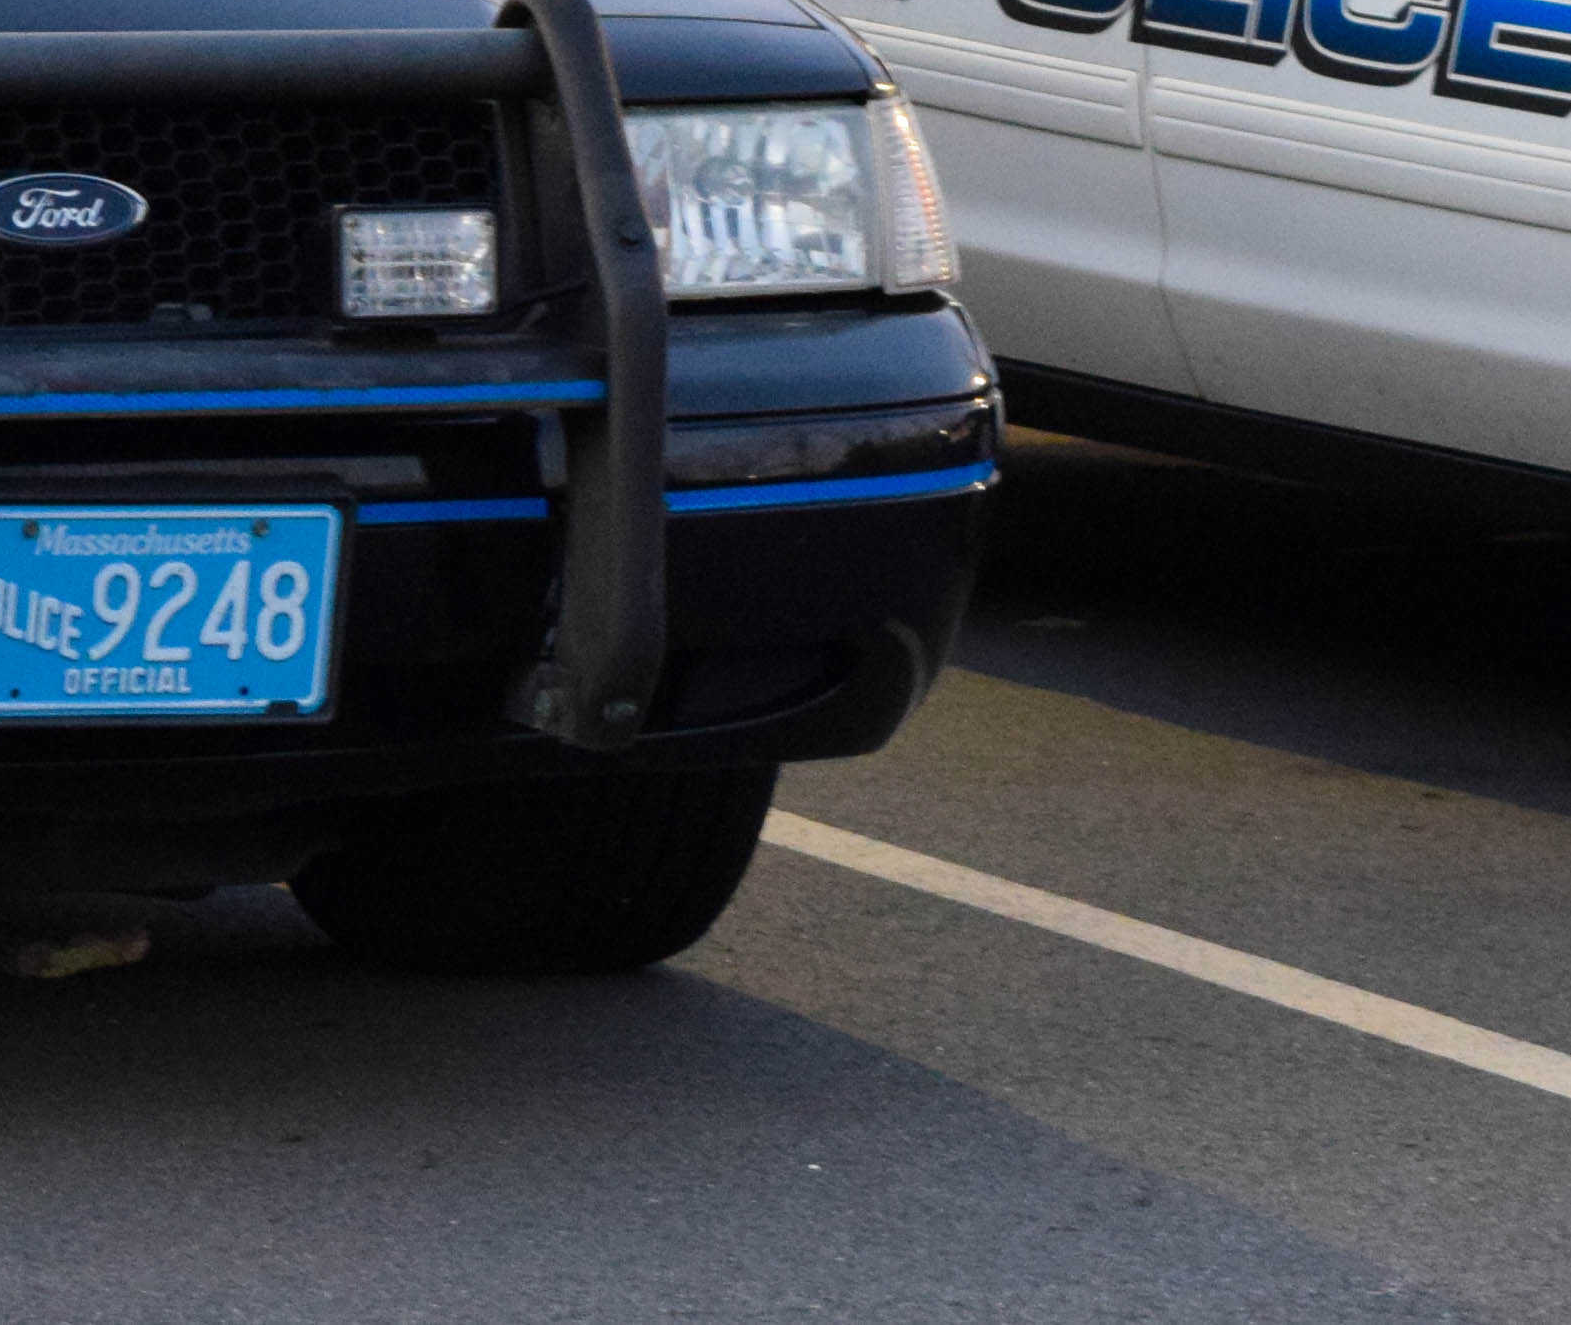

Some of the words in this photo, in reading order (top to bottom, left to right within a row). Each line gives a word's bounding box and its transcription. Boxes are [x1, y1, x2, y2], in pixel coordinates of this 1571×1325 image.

[12, 187, 105, 229] Ford
[34, 524, 252, 556] Massachusetts
[87, 560, 310, 662] 9248
[63, 666, 192, 695] OFFICIAL
